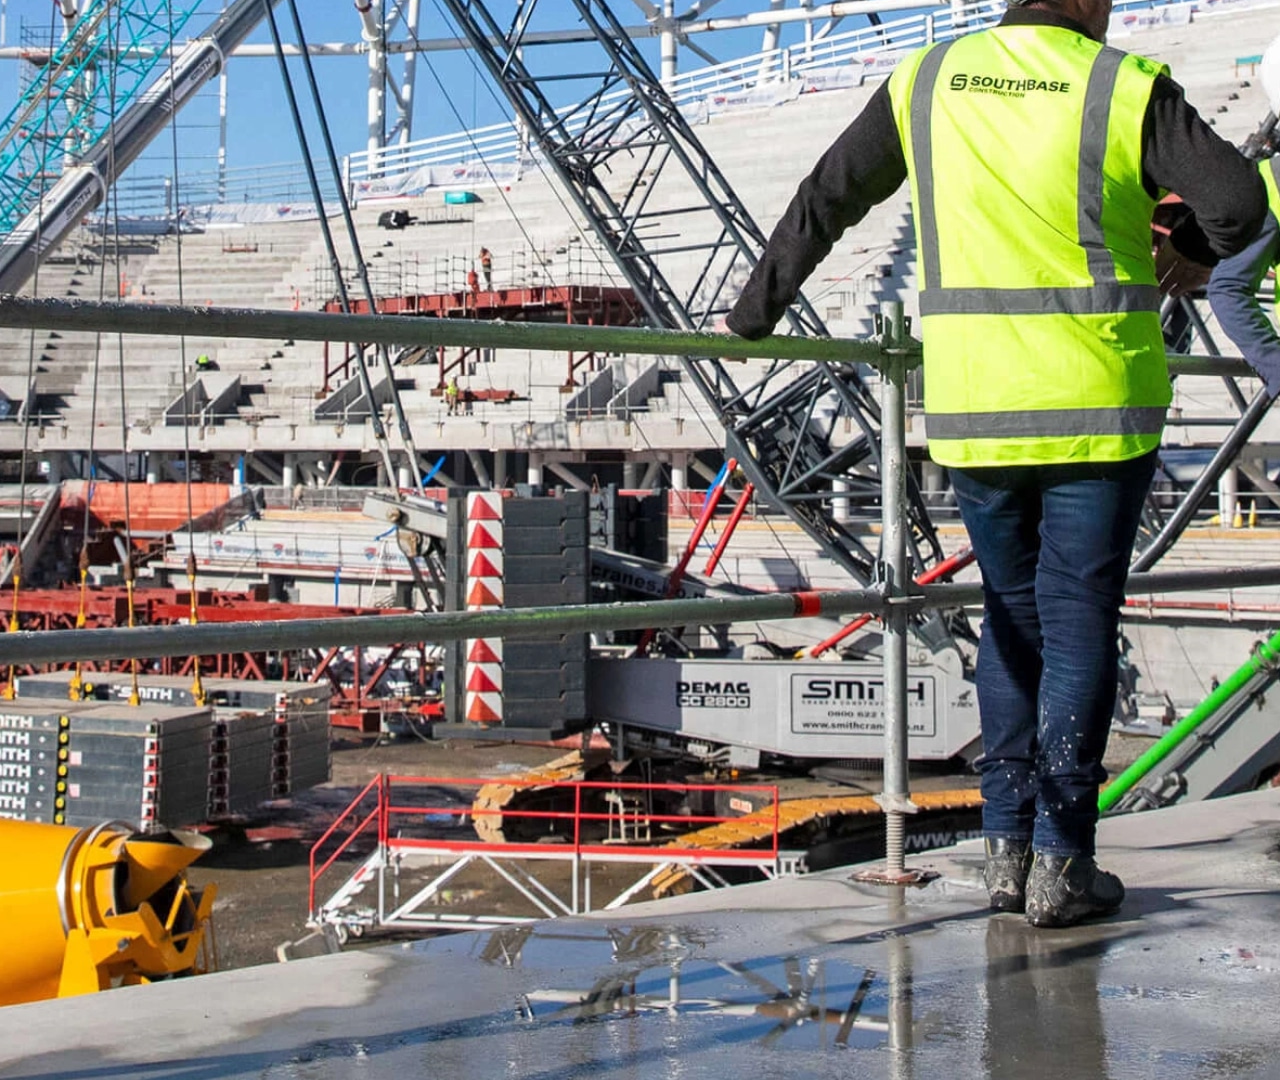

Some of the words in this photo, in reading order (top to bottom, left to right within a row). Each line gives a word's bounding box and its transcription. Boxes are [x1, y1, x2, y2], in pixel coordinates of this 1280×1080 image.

[970, 75, 1070, 93] SOUTHBASE
[968, 86, 1025, 98] CONSTRUCTION
[676, 681, 750, 694] DEMAG
[679, 696, 702, 707] CC
[704, 696, 749, 707] 2800
